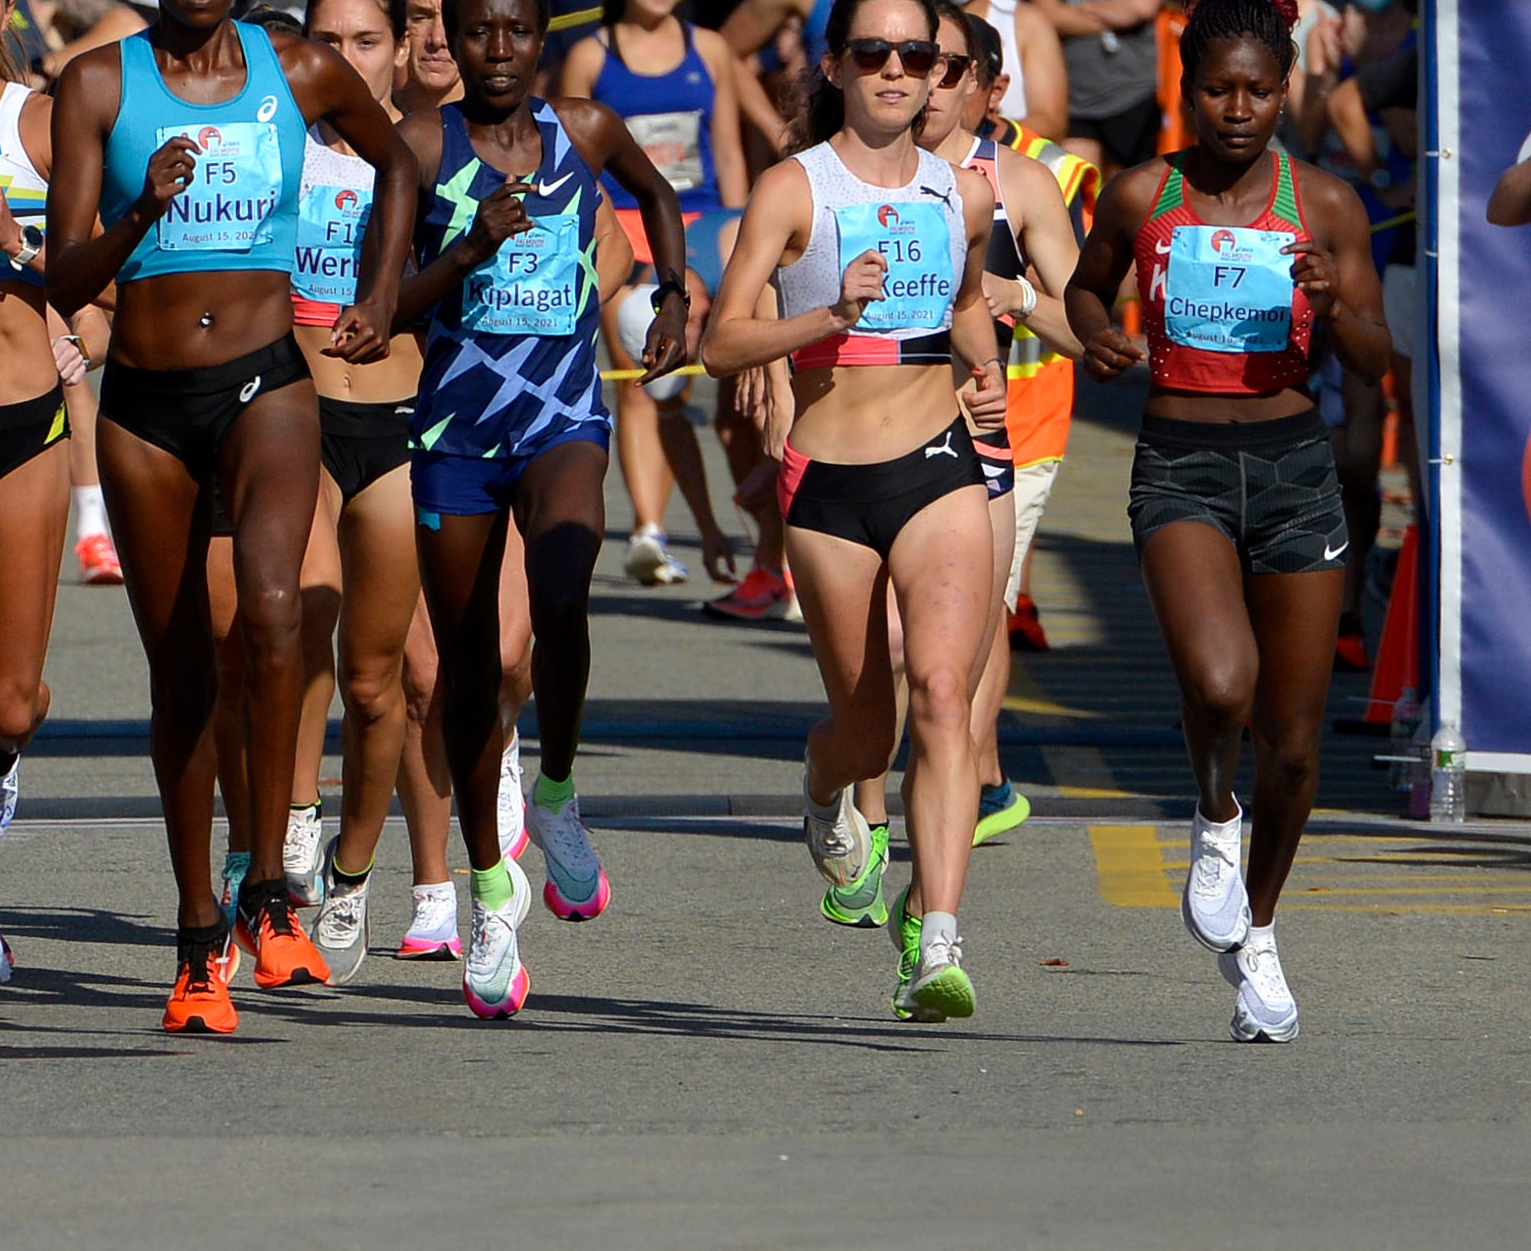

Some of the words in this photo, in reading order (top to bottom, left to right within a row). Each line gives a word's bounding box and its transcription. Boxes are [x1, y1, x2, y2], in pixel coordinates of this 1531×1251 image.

[205, 162, 237, 184] F5
[167, 190, 277, 224] Nukuri
[182, 233, 213, 244] August
[877, 239, 921, 263] F16
[509, 252, 538, 274] F3
[1213, 265, 1246, 288] F7
[308, 284, 338, 295] August
[468, 279, 572, 312] Kiplagat
[911, 310, 934, 319] 2021
[1169, 297, 1286, 322] Chepkemoi
[482, 316, 513, 327] August
[534, 317, 557, 327] 2021
